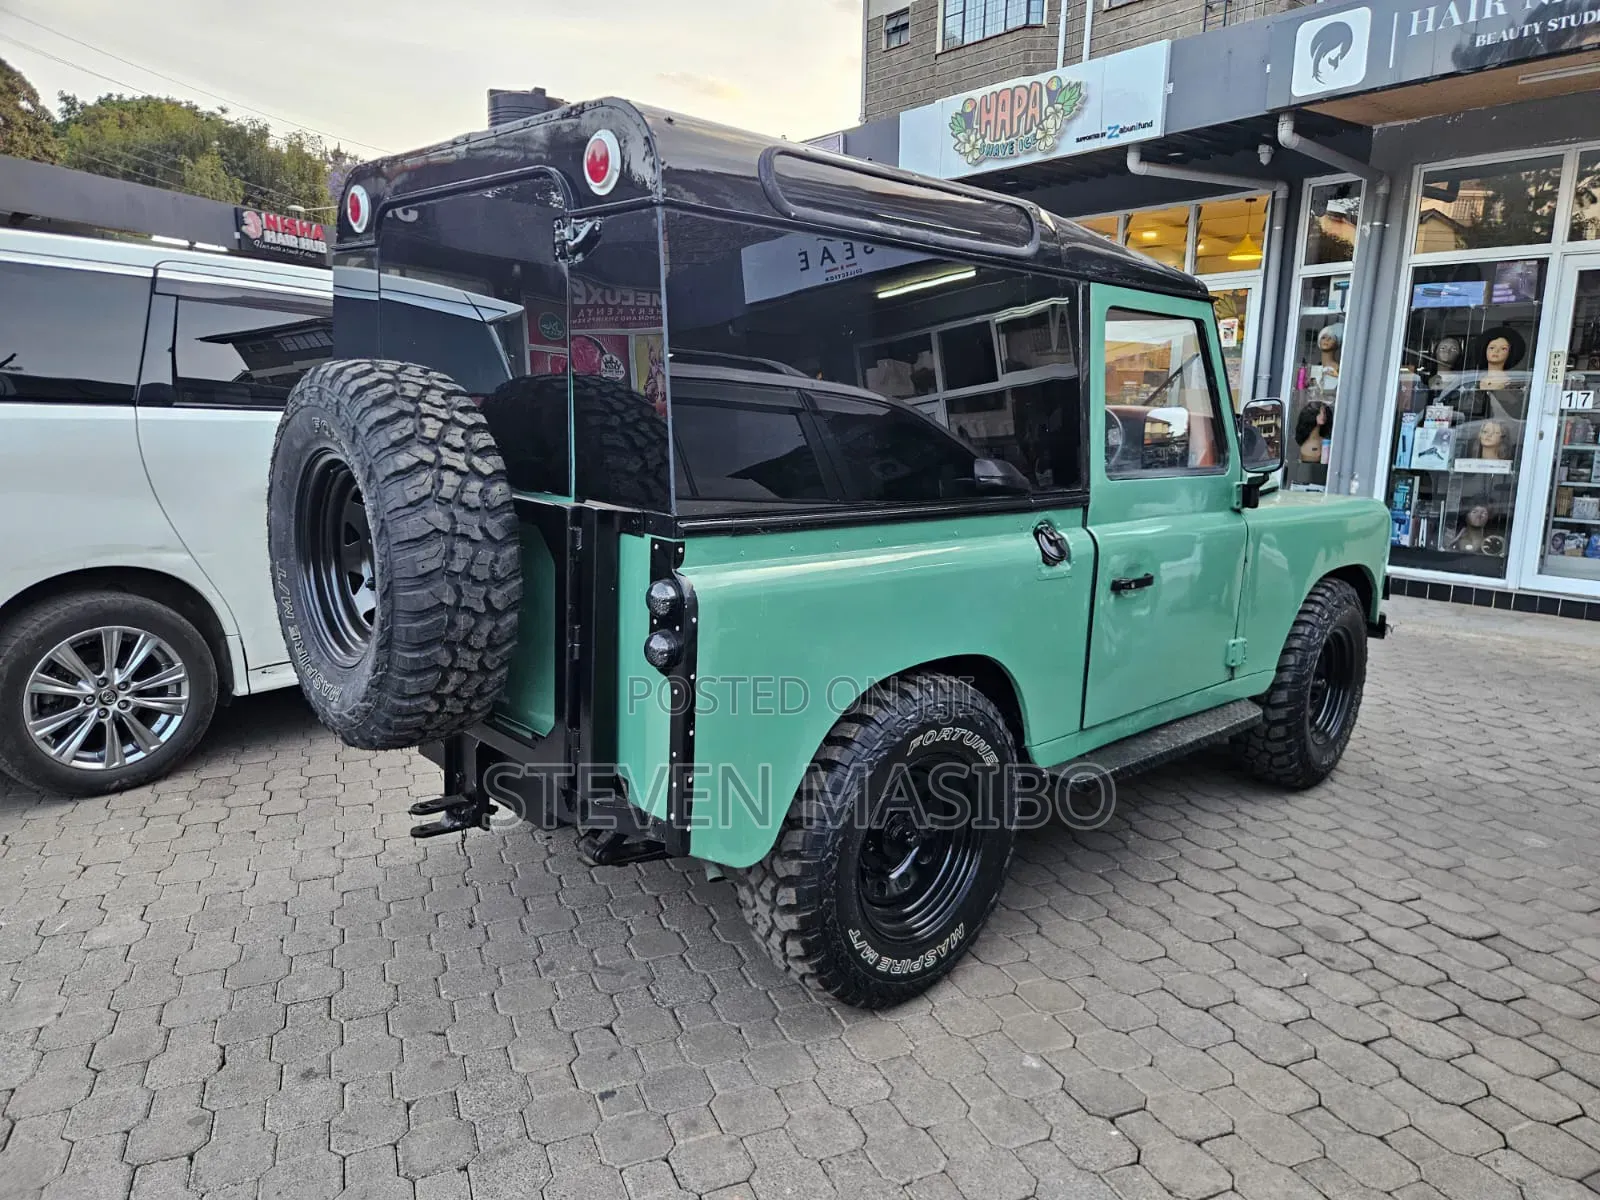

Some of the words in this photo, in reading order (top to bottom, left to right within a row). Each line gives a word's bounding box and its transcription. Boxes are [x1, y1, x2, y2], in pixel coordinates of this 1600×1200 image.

[1408, 0, 1508, 37] HAIR
[1475, 21, 1543, 47] BEAUTY
[979, 81, 1042, 142] HAPA
[980, 141, 1014, 157] SHAVE
[1019, 133, 1037, 151] ICE
[261, 211, 326, 240] NISHA
[264, 230, 298, 248] HAIR
[299, 238, 327, 253] HUB
[1551, 353, 1561, 380] PUSH
[1566, 392, 1591, 407] 17
[906, 727, 1000, 767] FORTUNE
[876, 922, 965, 974] MASPIRE
